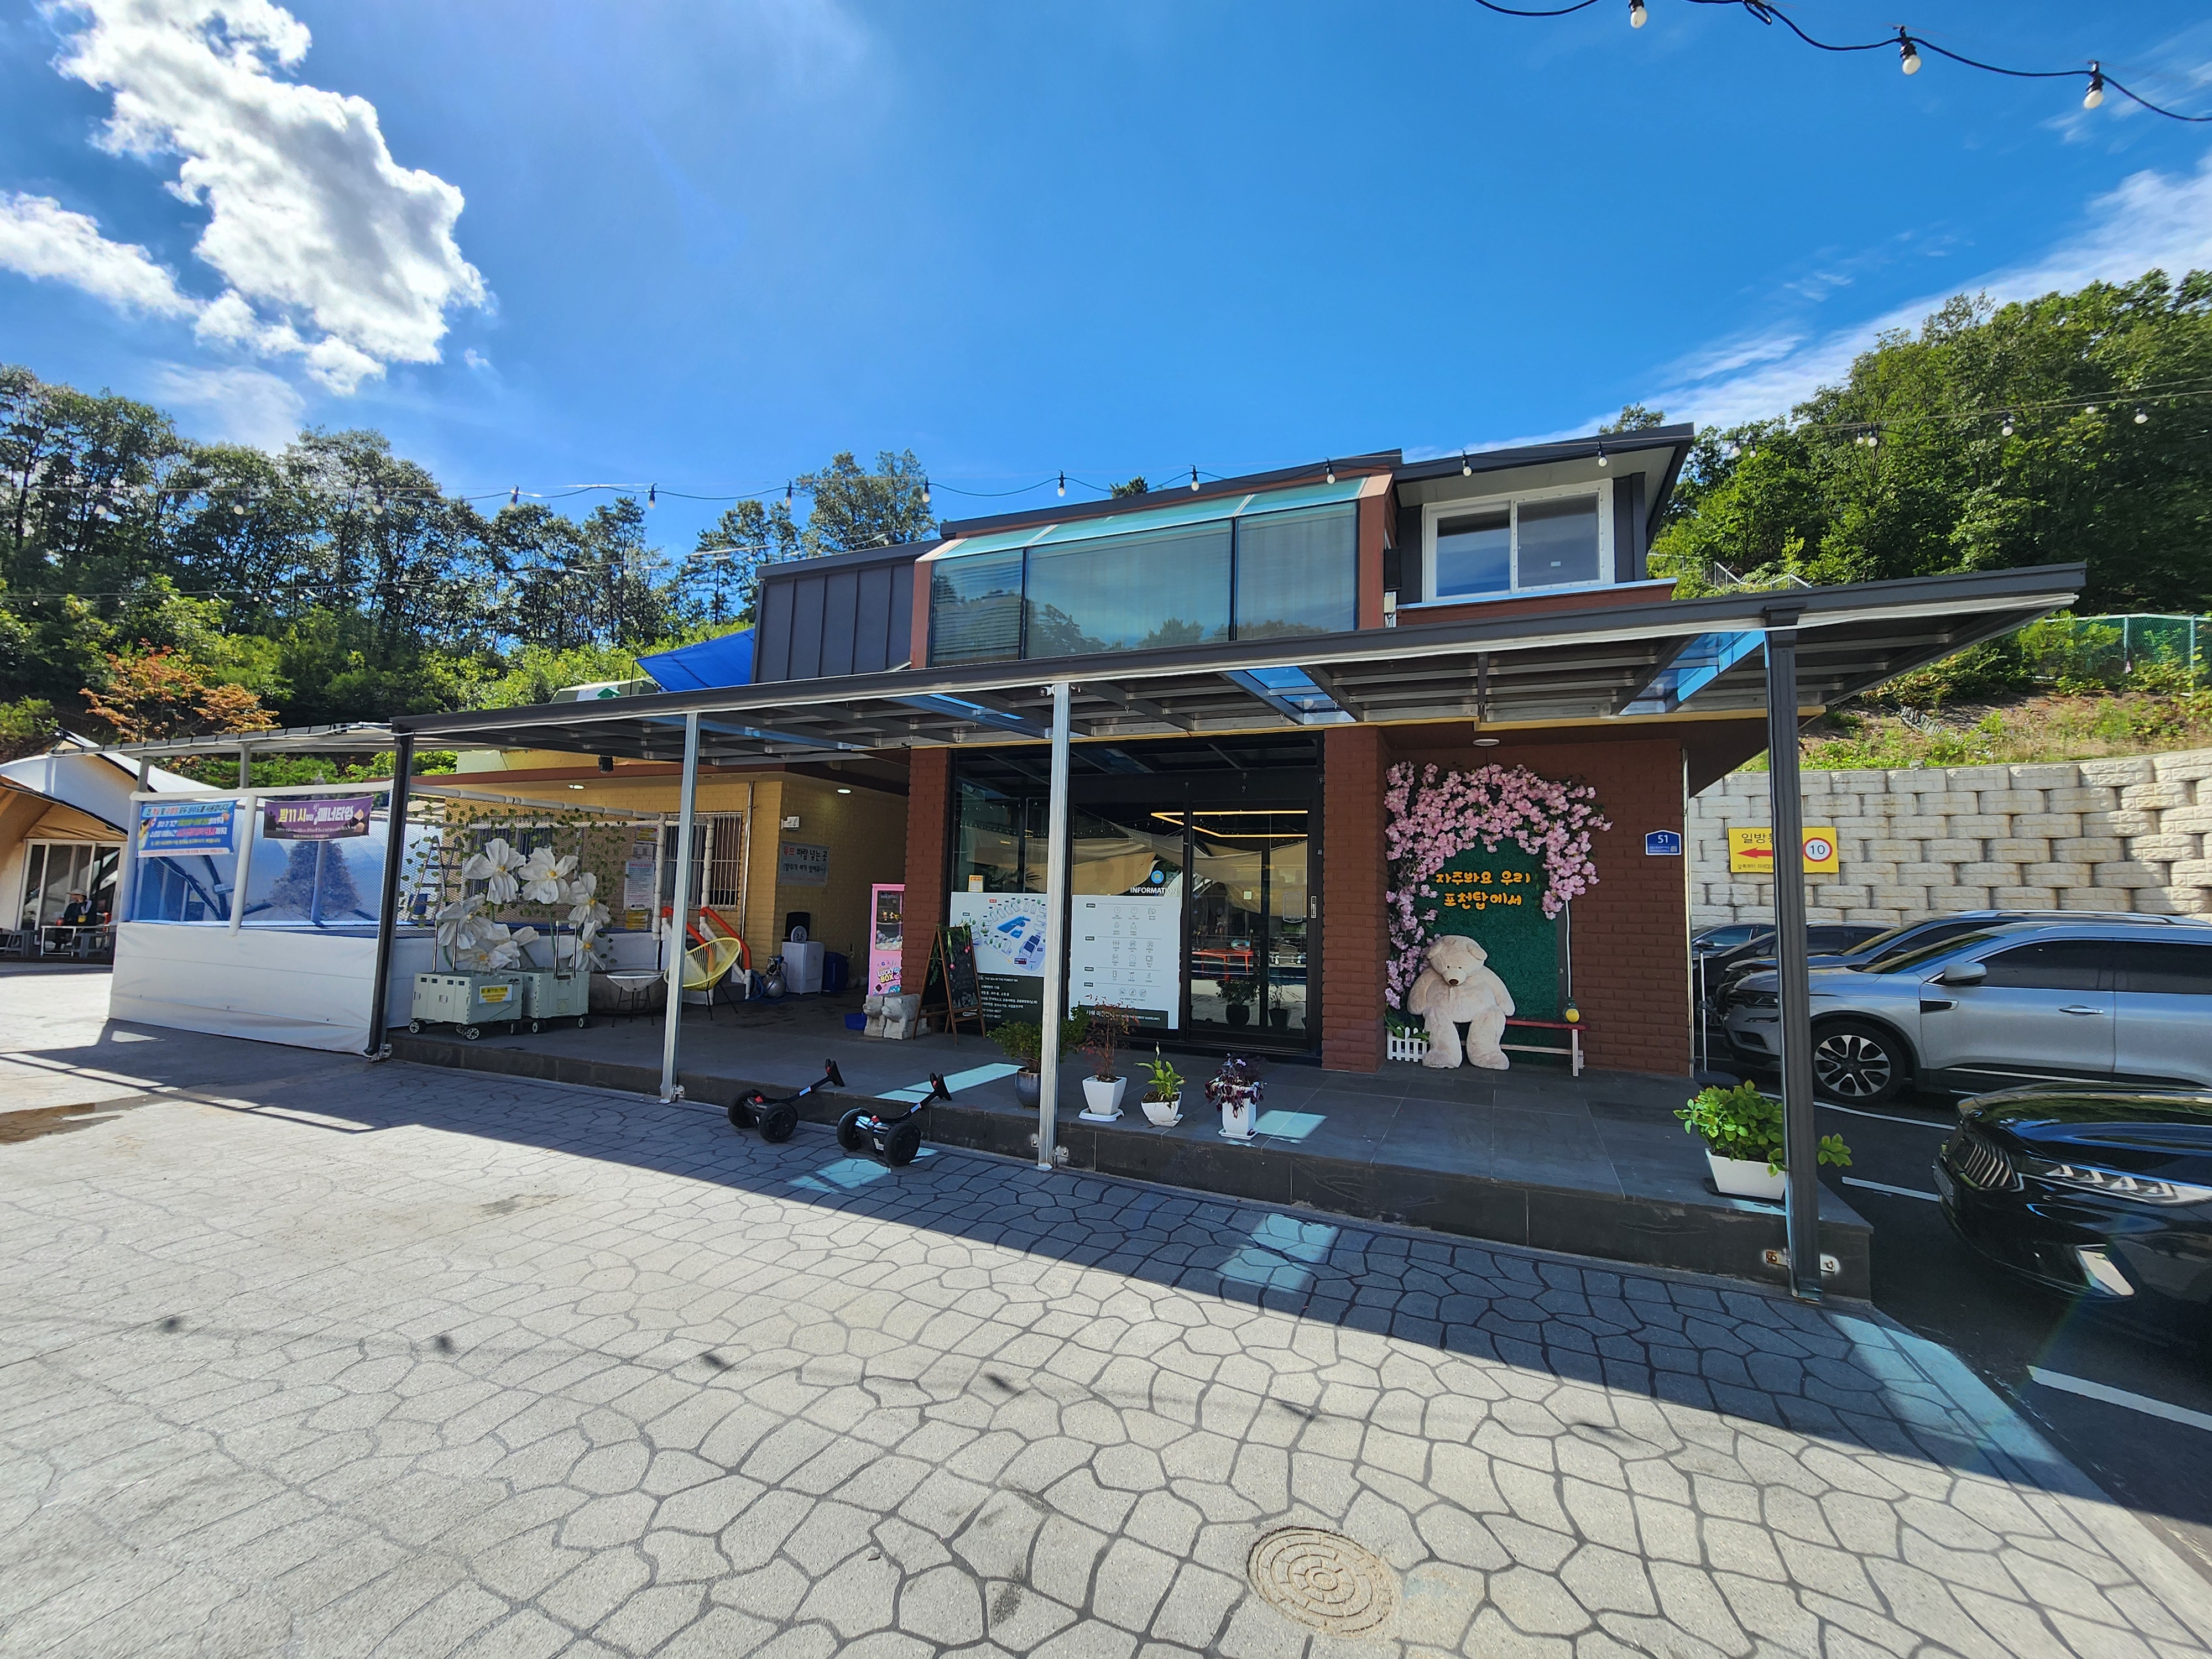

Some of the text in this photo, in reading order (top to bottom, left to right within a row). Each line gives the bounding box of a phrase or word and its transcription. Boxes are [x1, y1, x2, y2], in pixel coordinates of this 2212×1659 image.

[316, 806, 354, 823] 매너타임
[1657, 834, 1668, 844] 51
[797, 848, 808, 860] 바람
[822, 851, 827, 862] 곳
[1809, 844, 1825, 855] 10
[1436, 870, 1531, 885] 자주봐요 우리
[1444, 891, 1522, 910] 포천탑에서
[877, 967, 894, 977] LUCKY
[880, 974, 894, 983] BOX
